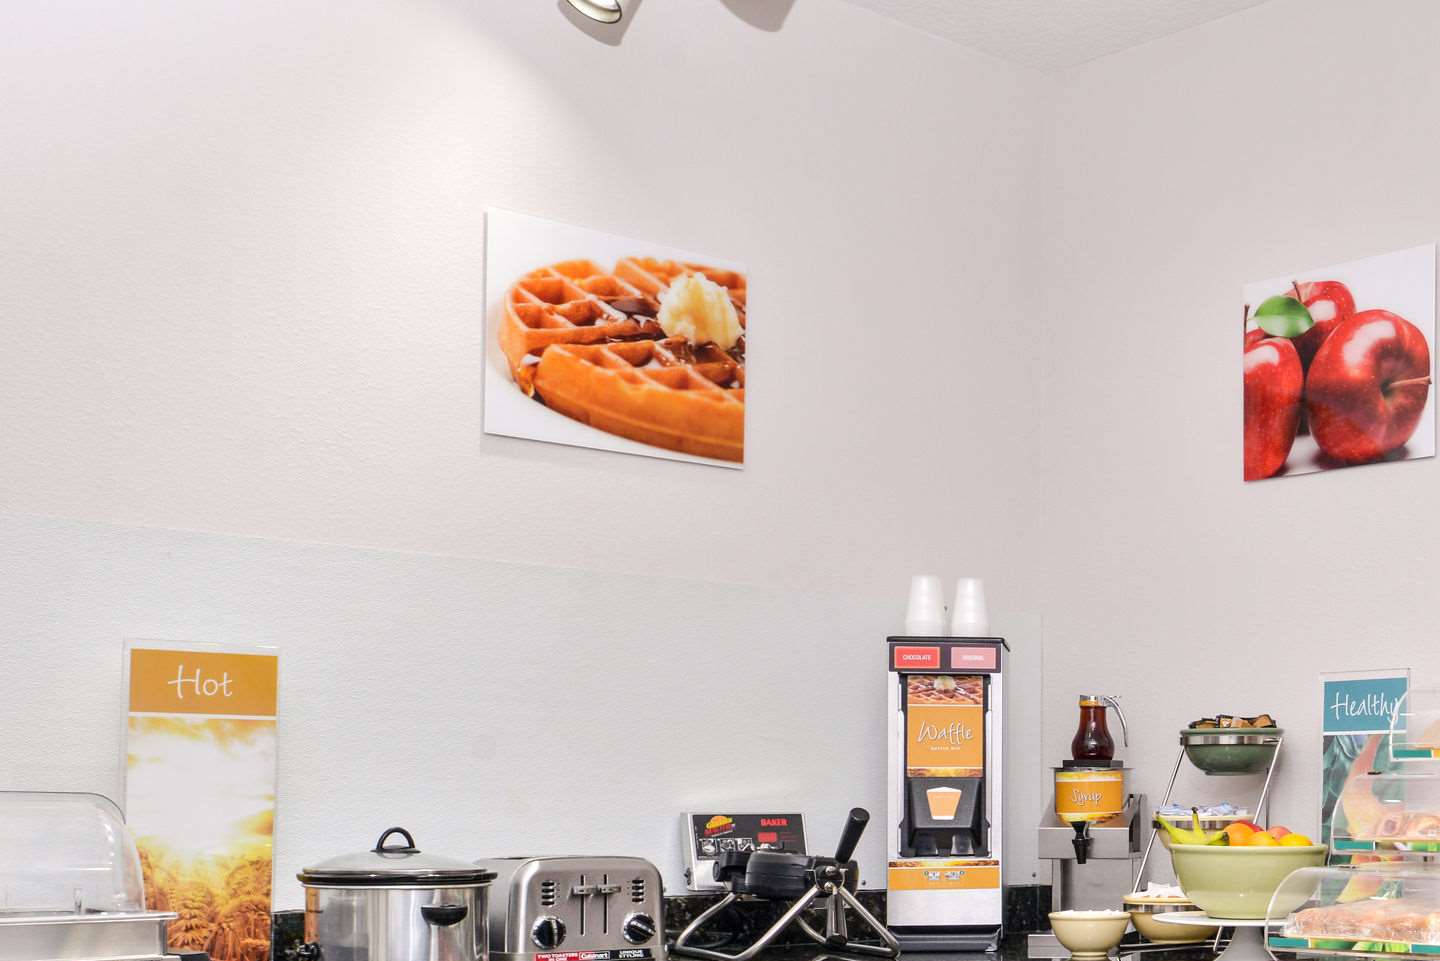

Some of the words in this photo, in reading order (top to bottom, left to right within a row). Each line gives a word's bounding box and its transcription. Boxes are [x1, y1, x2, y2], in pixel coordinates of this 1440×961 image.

[167, 664, 233, 699] Hot
[1330, 692, 1399, 724] Healthy
[917, 719, 974, 745] Waffle
[1072, 788, 1104, 807] Syrup
